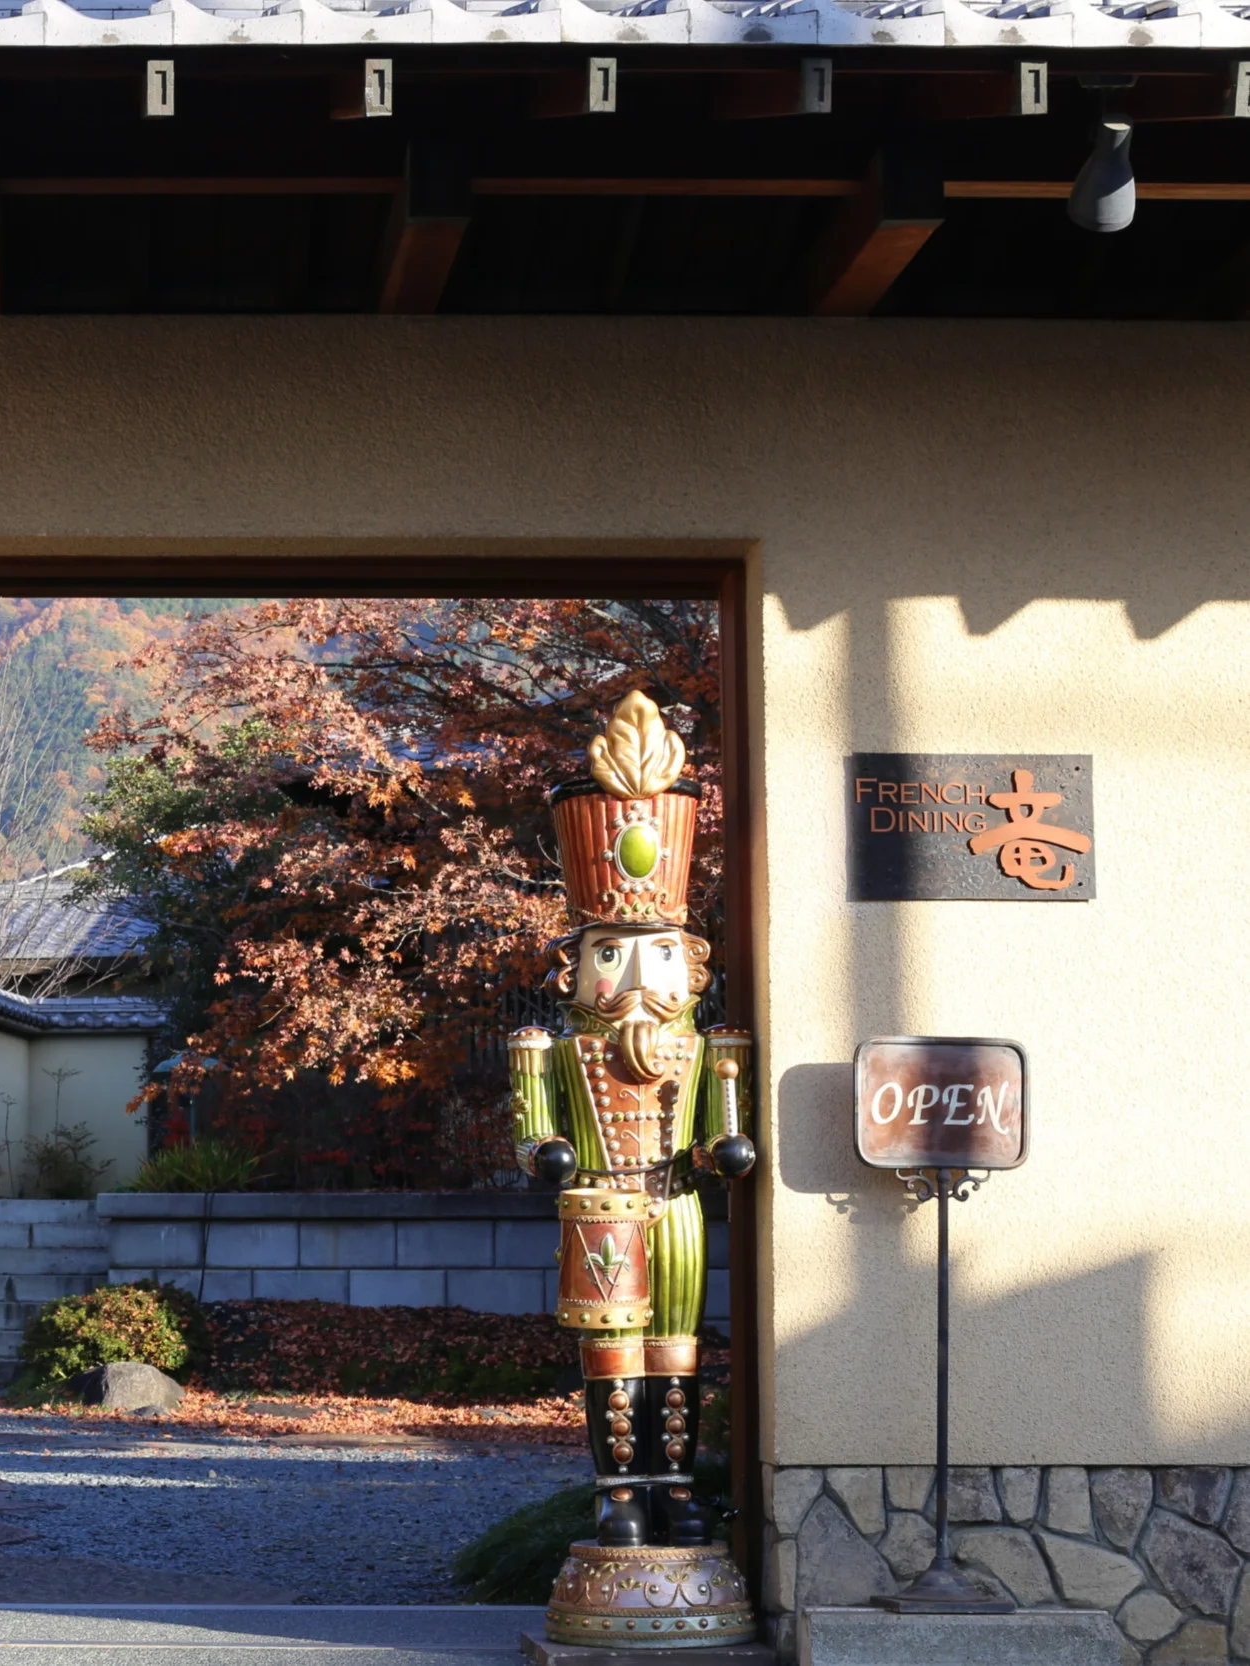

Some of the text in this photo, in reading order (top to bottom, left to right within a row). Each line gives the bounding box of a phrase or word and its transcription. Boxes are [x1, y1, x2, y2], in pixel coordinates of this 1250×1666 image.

[855, 778, 987, 805] FRENCH
[870, 807, 987, 834] DINING
[871, 1081, 1010, 1135] OPEN
